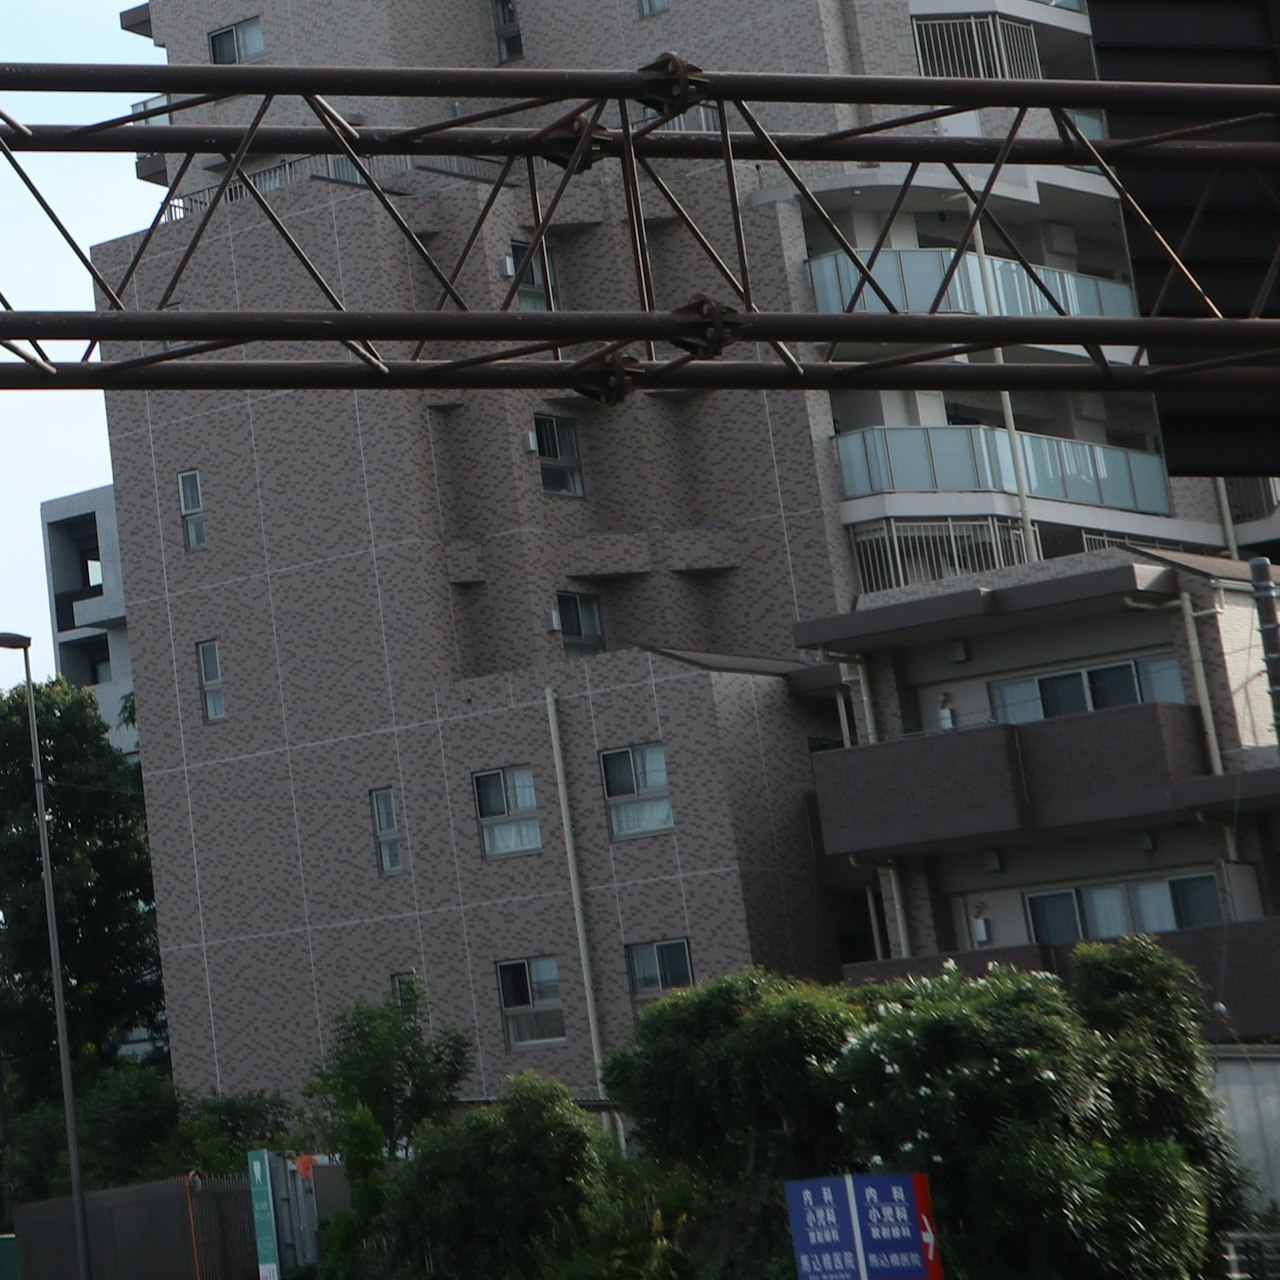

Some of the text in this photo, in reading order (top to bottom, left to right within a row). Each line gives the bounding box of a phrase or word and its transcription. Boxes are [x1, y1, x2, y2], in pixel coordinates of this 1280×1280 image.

[806, 1208, 837, 1227] 小児科
[868, 1206, 908, 1223] 小児科
